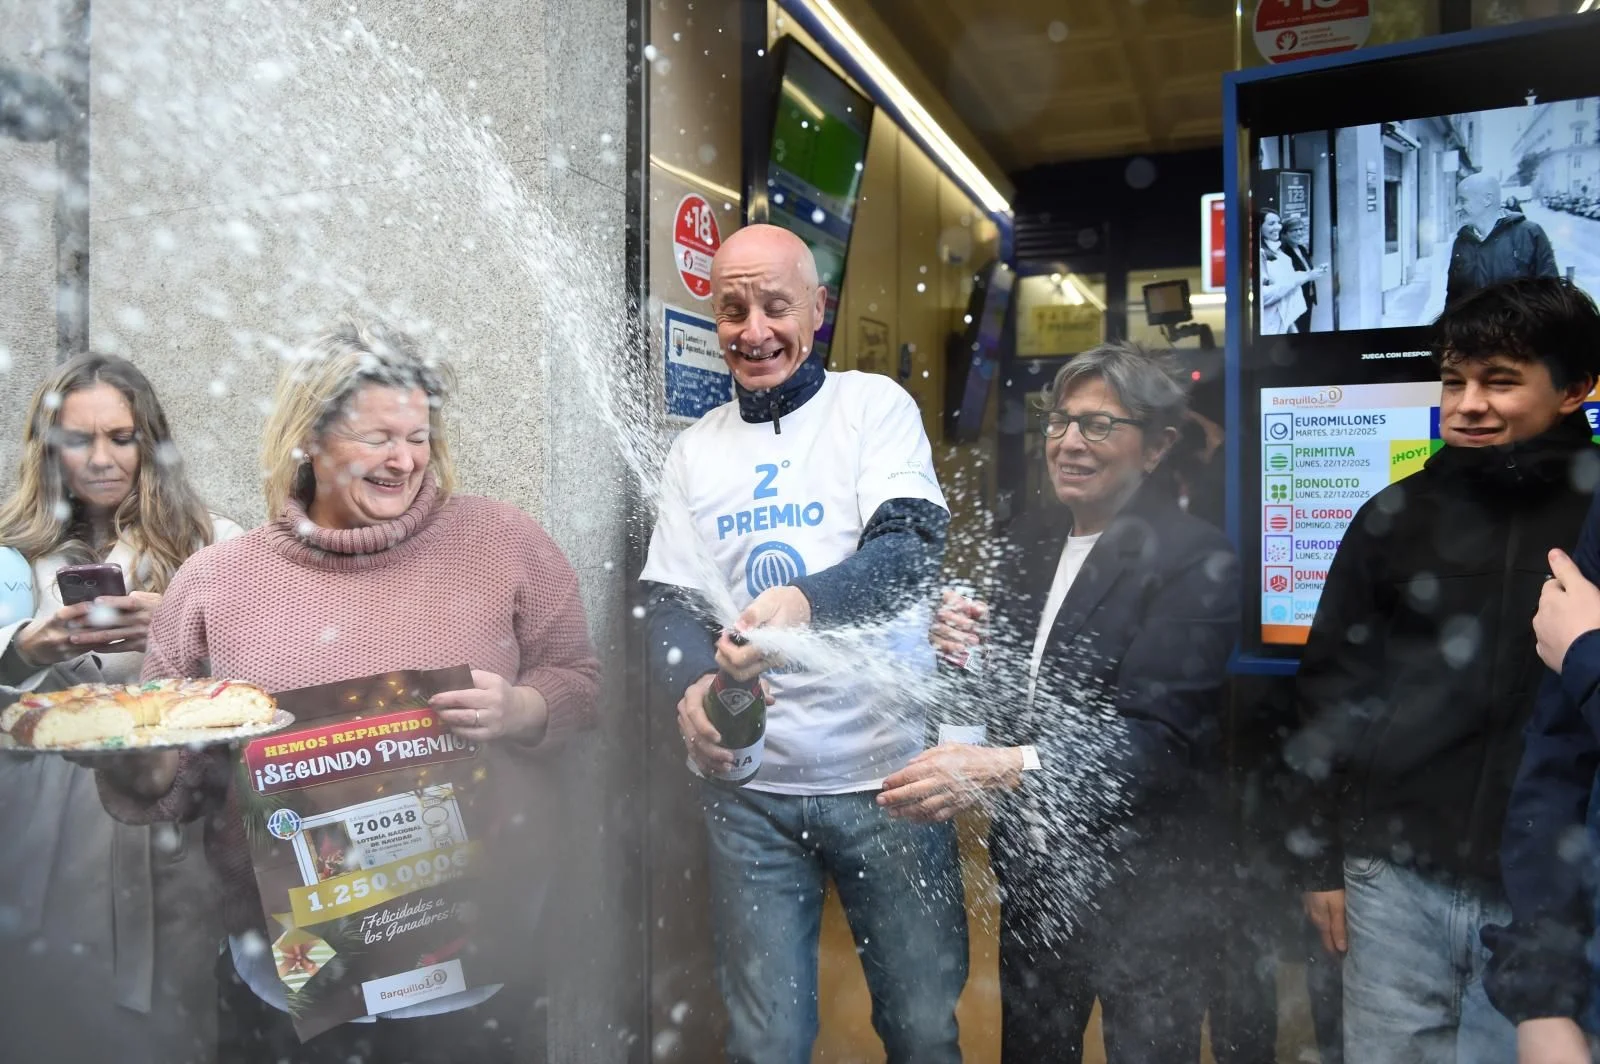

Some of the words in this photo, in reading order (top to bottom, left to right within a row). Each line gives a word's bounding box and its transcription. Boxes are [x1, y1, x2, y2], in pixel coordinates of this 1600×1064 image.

[684, 204, 712, 245] +18
[1361, 352, 1385, 360] JUEGA
[1296, 414, 1386, 427] EUROMILLONES
[1330, 427, 1377, 436] 23/12/2025
[1296, 447, 1355, 457] PRIMITIVA
[1392, 447, 1428, 464] ¡HOY!
[1324, 458, 1370, 467] 22/12/2025
[1296, 478, 1360, 488] BONOLOTO
[1323, 490, 1370, 498] 22/12/2025
[1296, 509, 1308, 519] EL
[1311, 509, 1352, 519] GORDO
[716, 502, 824, 540] PREMIO
[264, 736, 328, 758] HEMOS
[332, 717, 433, 744] REPARTIDO
[254, 748, 372, 792] ¡SEGUNDO
[354, 810, 416, 835] 70048
[388, 825, 422, 838] NACIONAL
[370, 840, 380, 848] DE
[382, 834, 412, 846] NAVIDAD
[360, 898, 432, 932] ¡Felicidades
[435, 898, 445, 907] a
[364, 928, 382, 945] los
